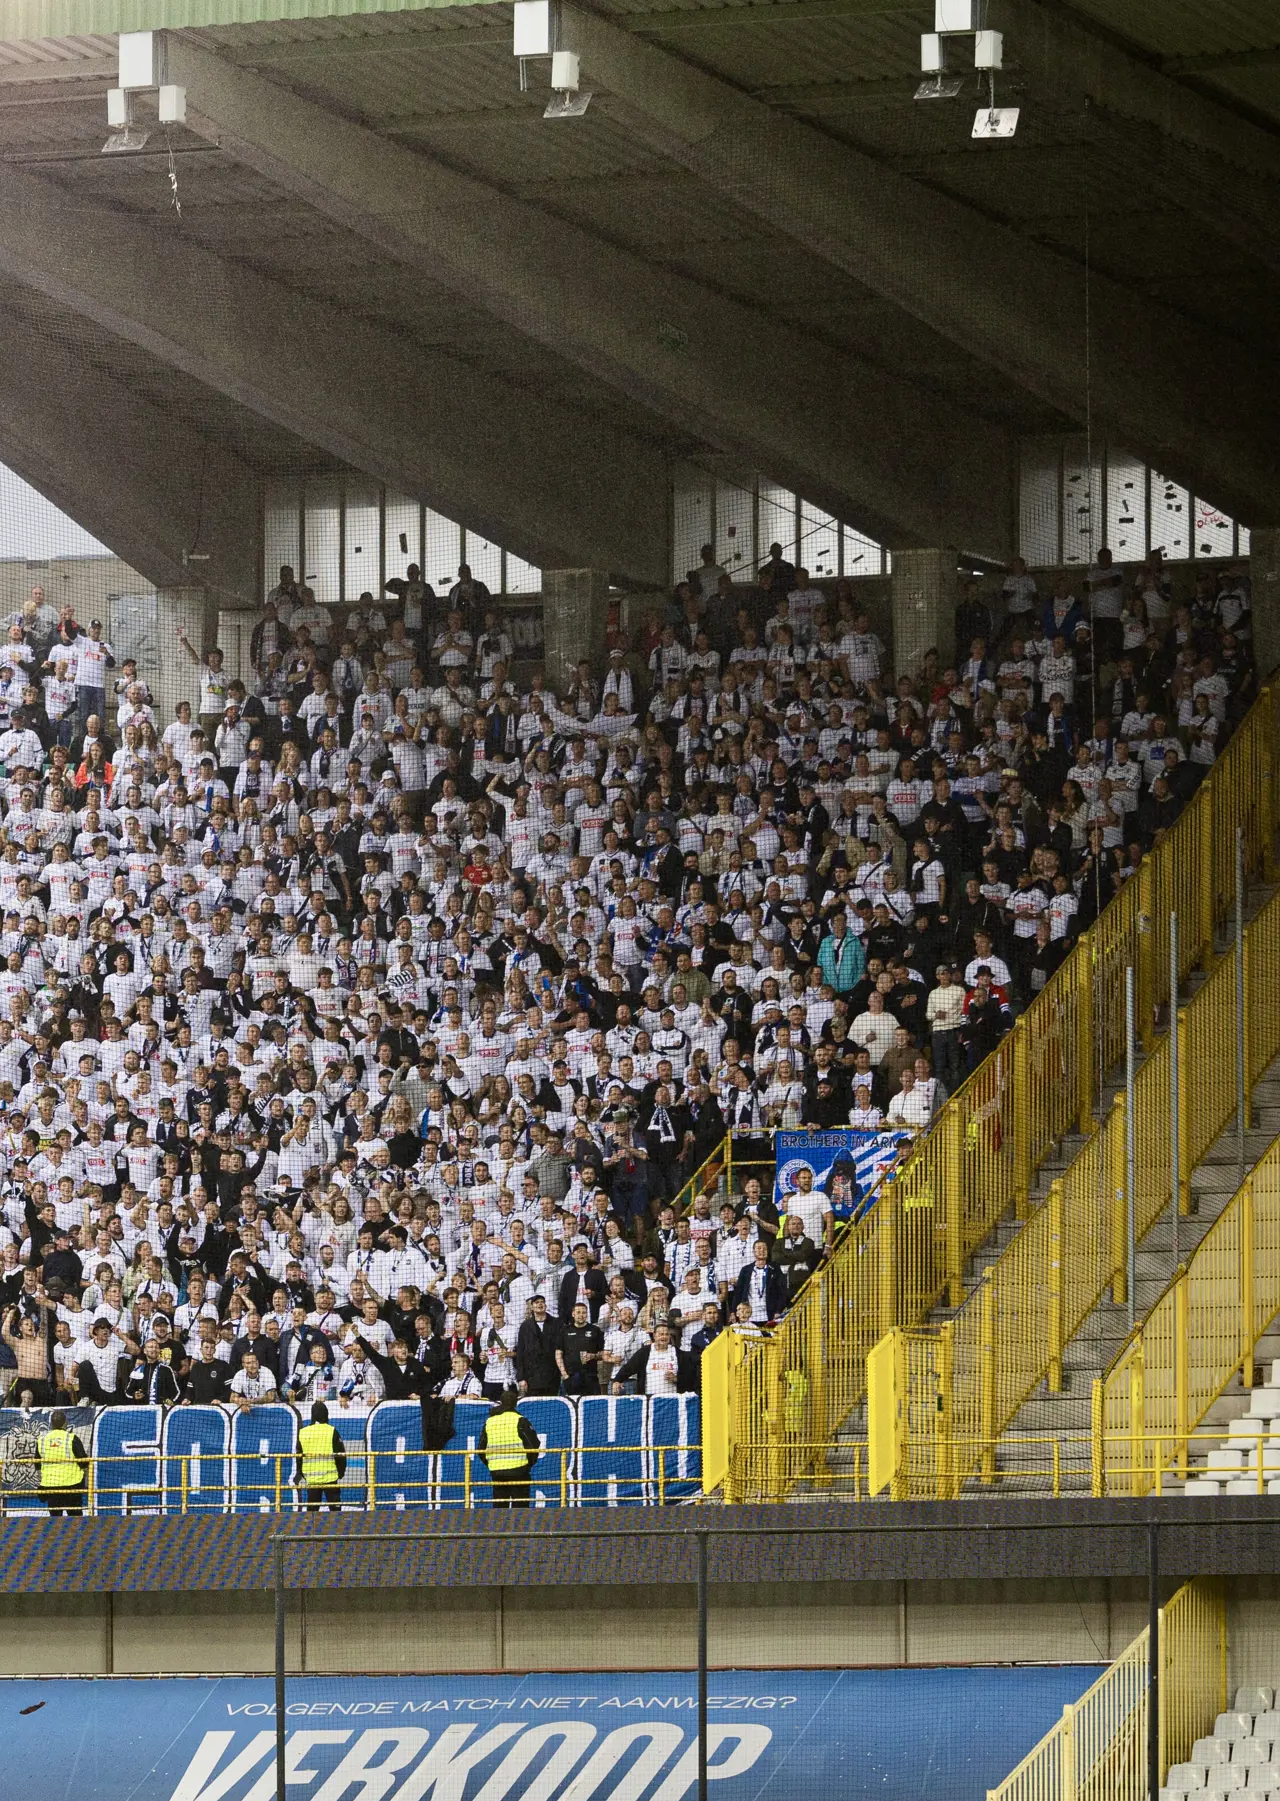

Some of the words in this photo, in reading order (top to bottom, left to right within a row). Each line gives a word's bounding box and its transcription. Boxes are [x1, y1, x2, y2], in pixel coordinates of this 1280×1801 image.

[895, 794, 915, 802] CERES
[781, 1134, 848, 1148] BROTHERS
[851, 1134, 865, 1147] IN
[870, 1135, 897, 1148] ARM
[225, 1702, 395, 1716] VOLGENDE
[400, 1698, 517, 1714] MATCH
[523, 1696, 598, 1710] NIET
[596, 1695, 798, 1710] AANWEZIG?
